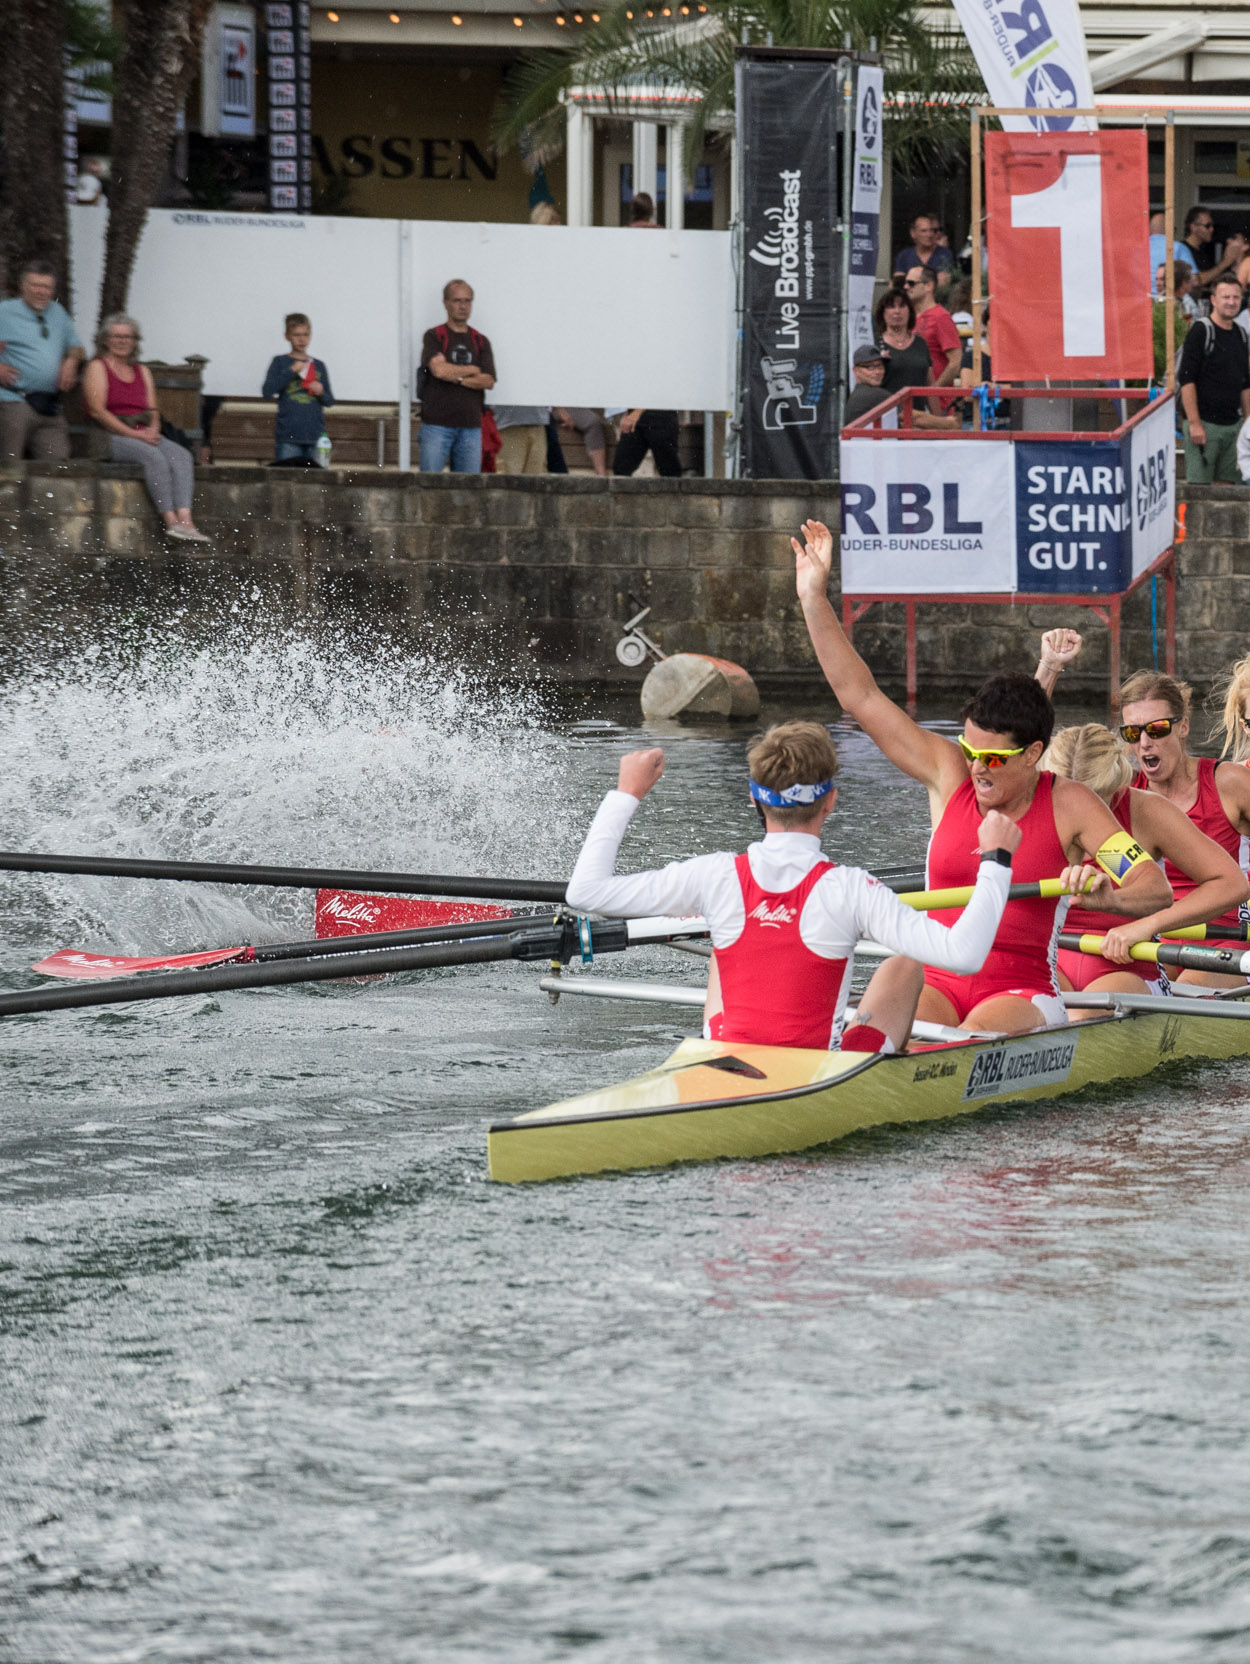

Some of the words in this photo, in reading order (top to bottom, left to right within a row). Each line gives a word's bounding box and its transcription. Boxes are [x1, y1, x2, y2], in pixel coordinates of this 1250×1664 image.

[859, 163, 878, 187] RBL
[775, 169, 801, 298] Broadcast
[1011, 154, 1105, 358] 1
[775, 302, 800, 350] Live
[841, 483, 983, 534] RBL
[841, 538, 983, 551] UDER-BUNDESLIGA
[1028, 542, 1108, 570] GUT.
[320, 896, 376, 923] Melitta
[748, 900, 793, 924] Melitta
[979, 1050, 1008, 1086] RBL
[1004, 1044, 1075, 1082] RUDER-BUNDESLIGA
